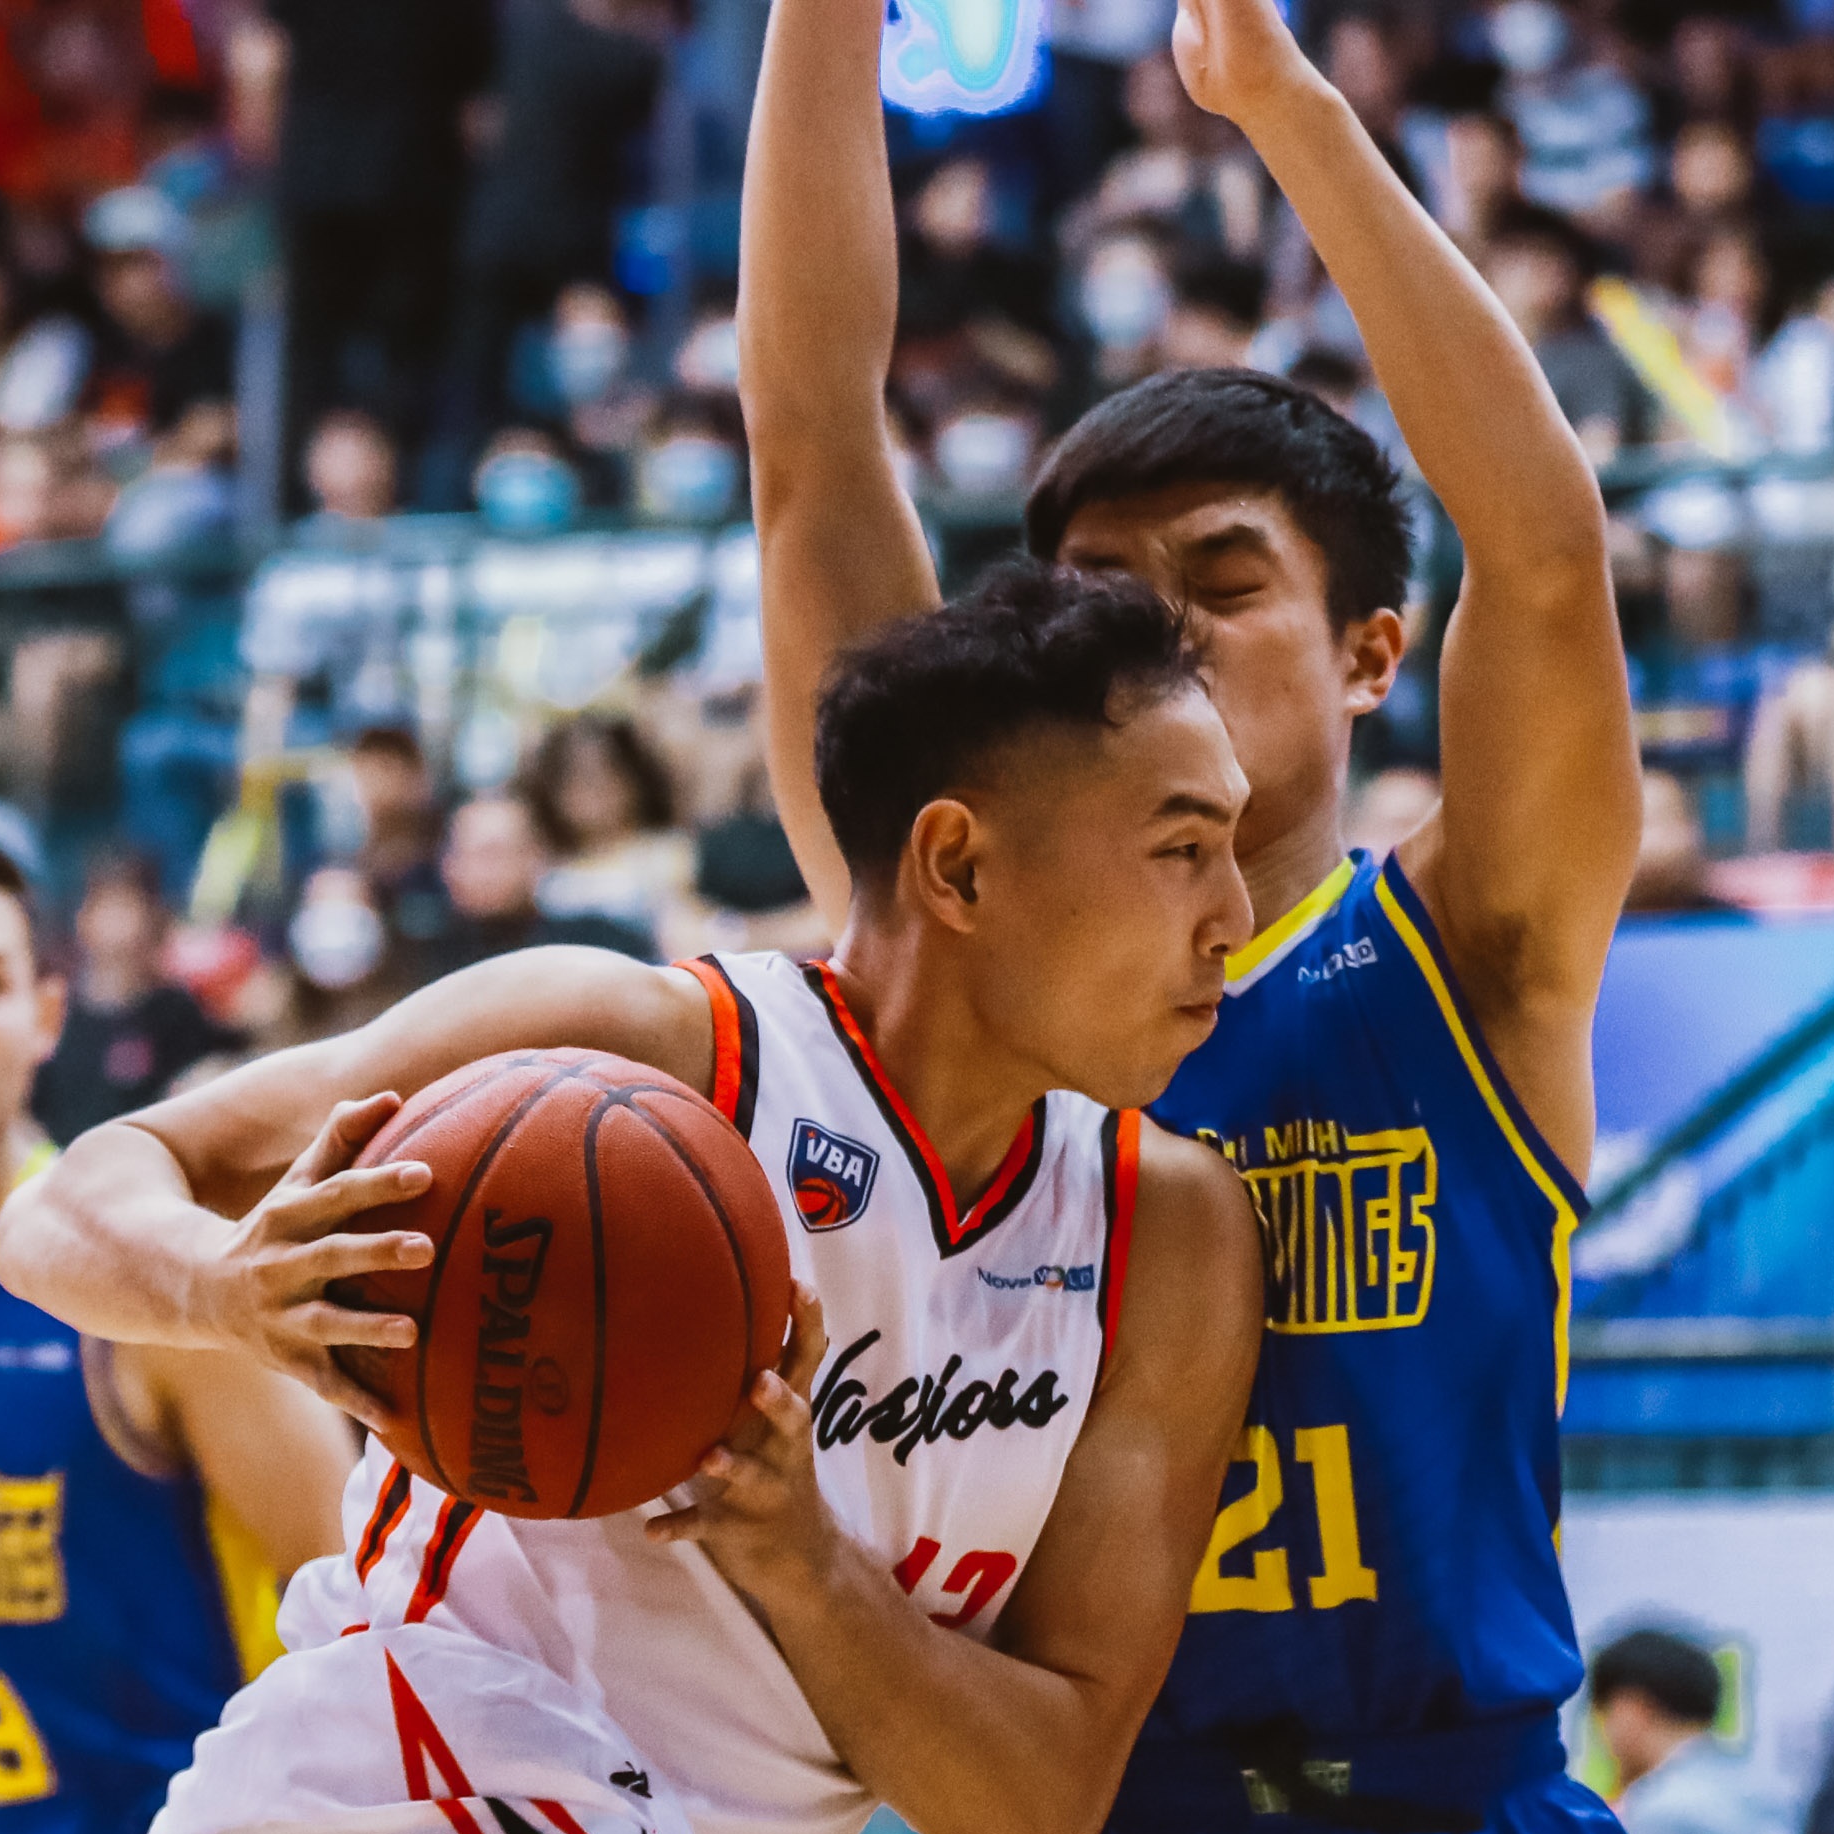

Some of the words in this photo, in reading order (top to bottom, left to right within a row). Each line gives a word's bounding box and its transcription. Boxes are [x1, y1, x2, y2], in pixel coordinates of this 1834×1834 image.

[805, 1137, 865, 1189] VBA
[467, 1205, 555, 1505] SPALDING
[1187, 1424, 1379, 1614] 21
